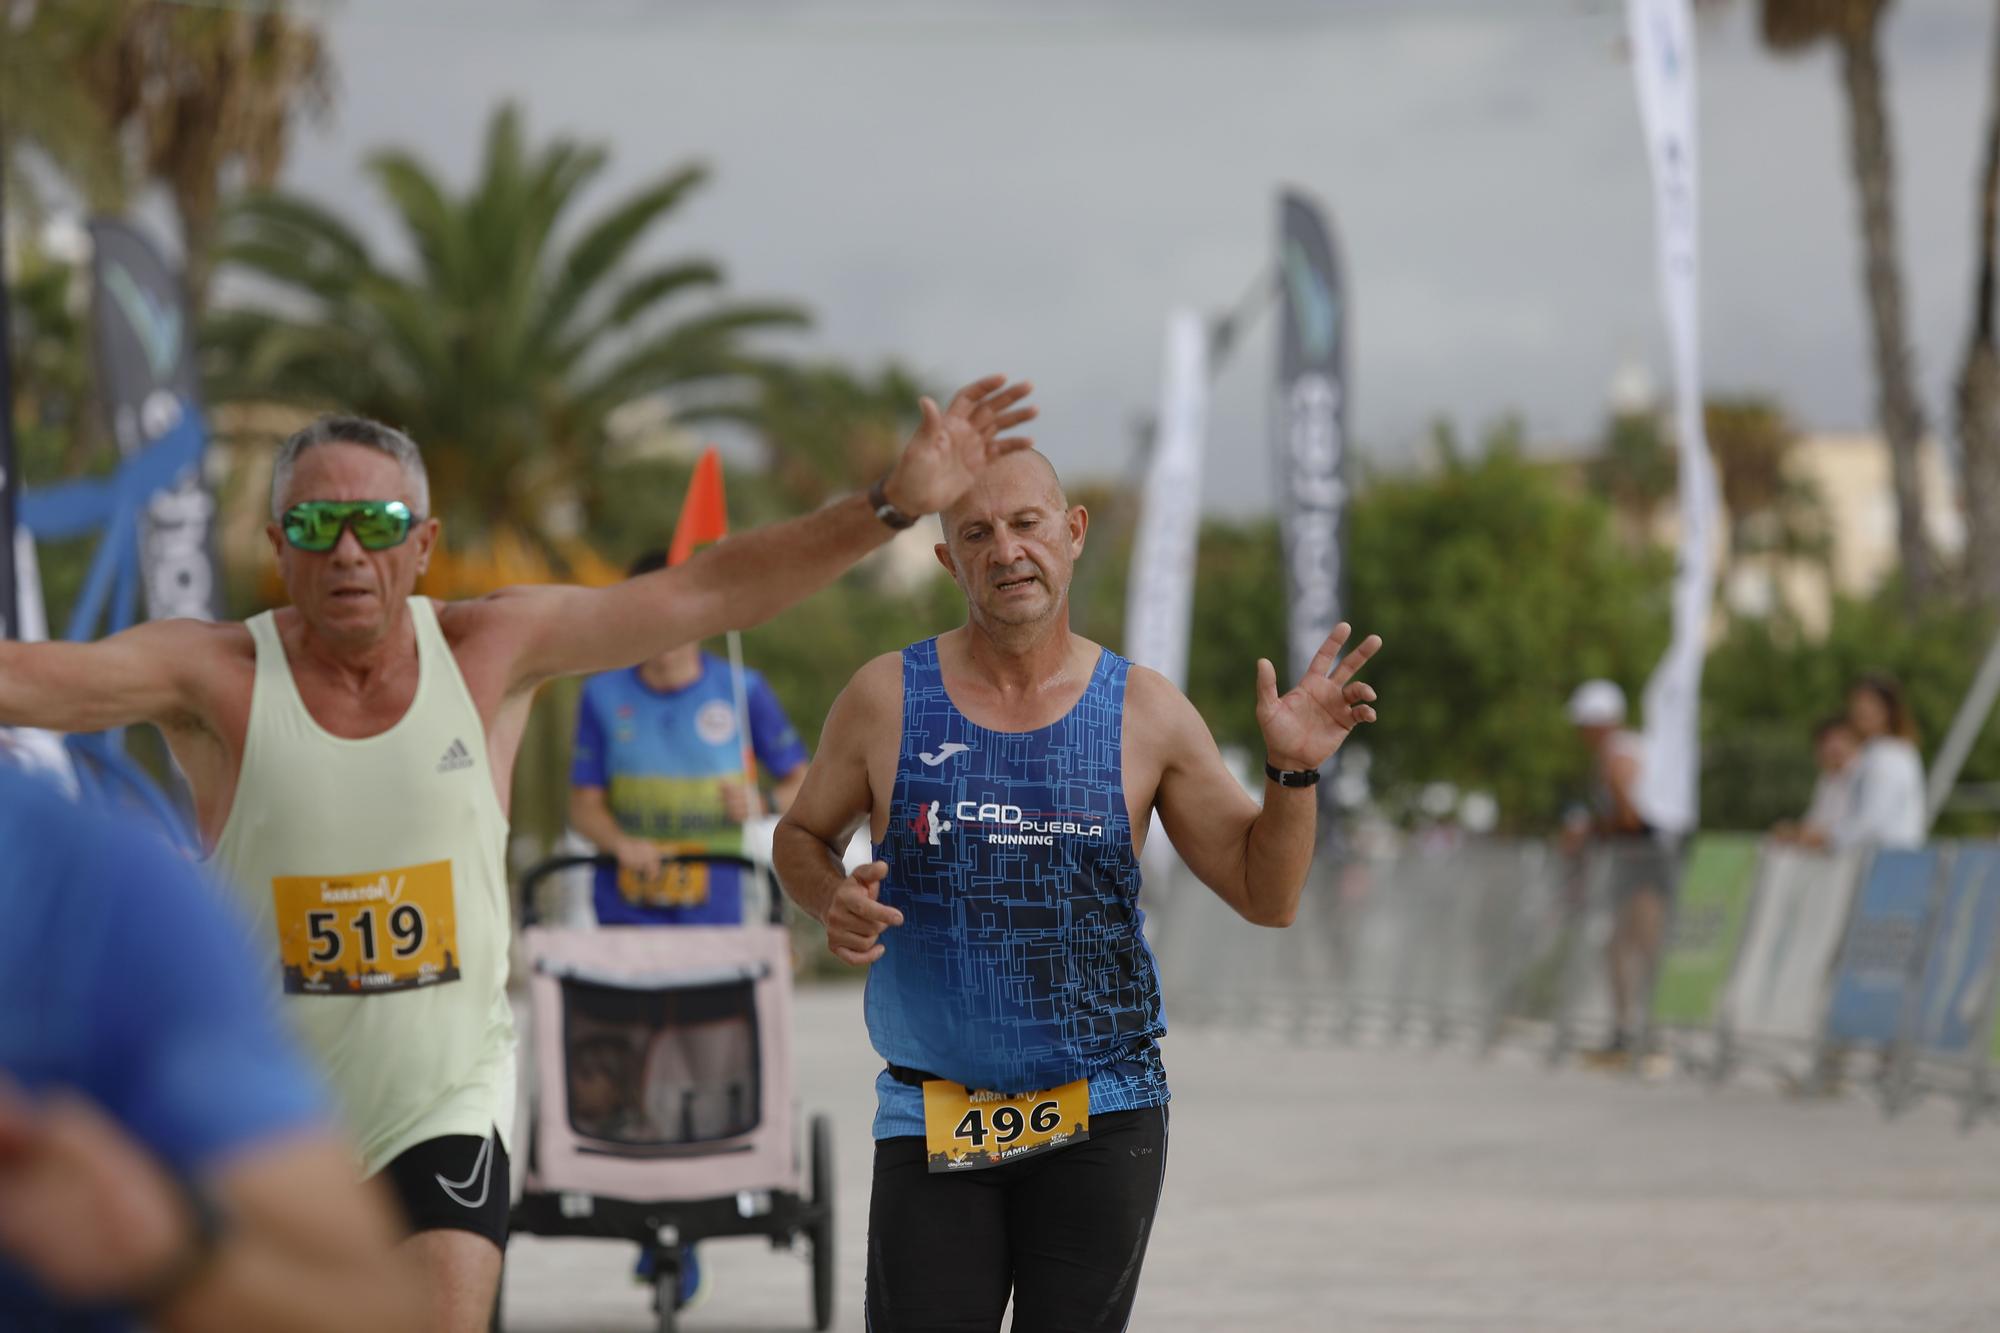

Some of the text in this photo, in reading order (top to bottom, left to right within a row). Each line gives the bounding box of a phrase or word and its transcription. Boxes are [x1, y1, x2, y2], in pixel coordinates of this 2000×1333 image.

[956, 801, 1102, 837] CAD PUEBLA
[988, 834, 1054, 846] RUNNING
[307, 903, 425, 963] 519
[954, 1101, 1061, 1147] 496
[1001, 1145, 1029, 1158] FAMU
